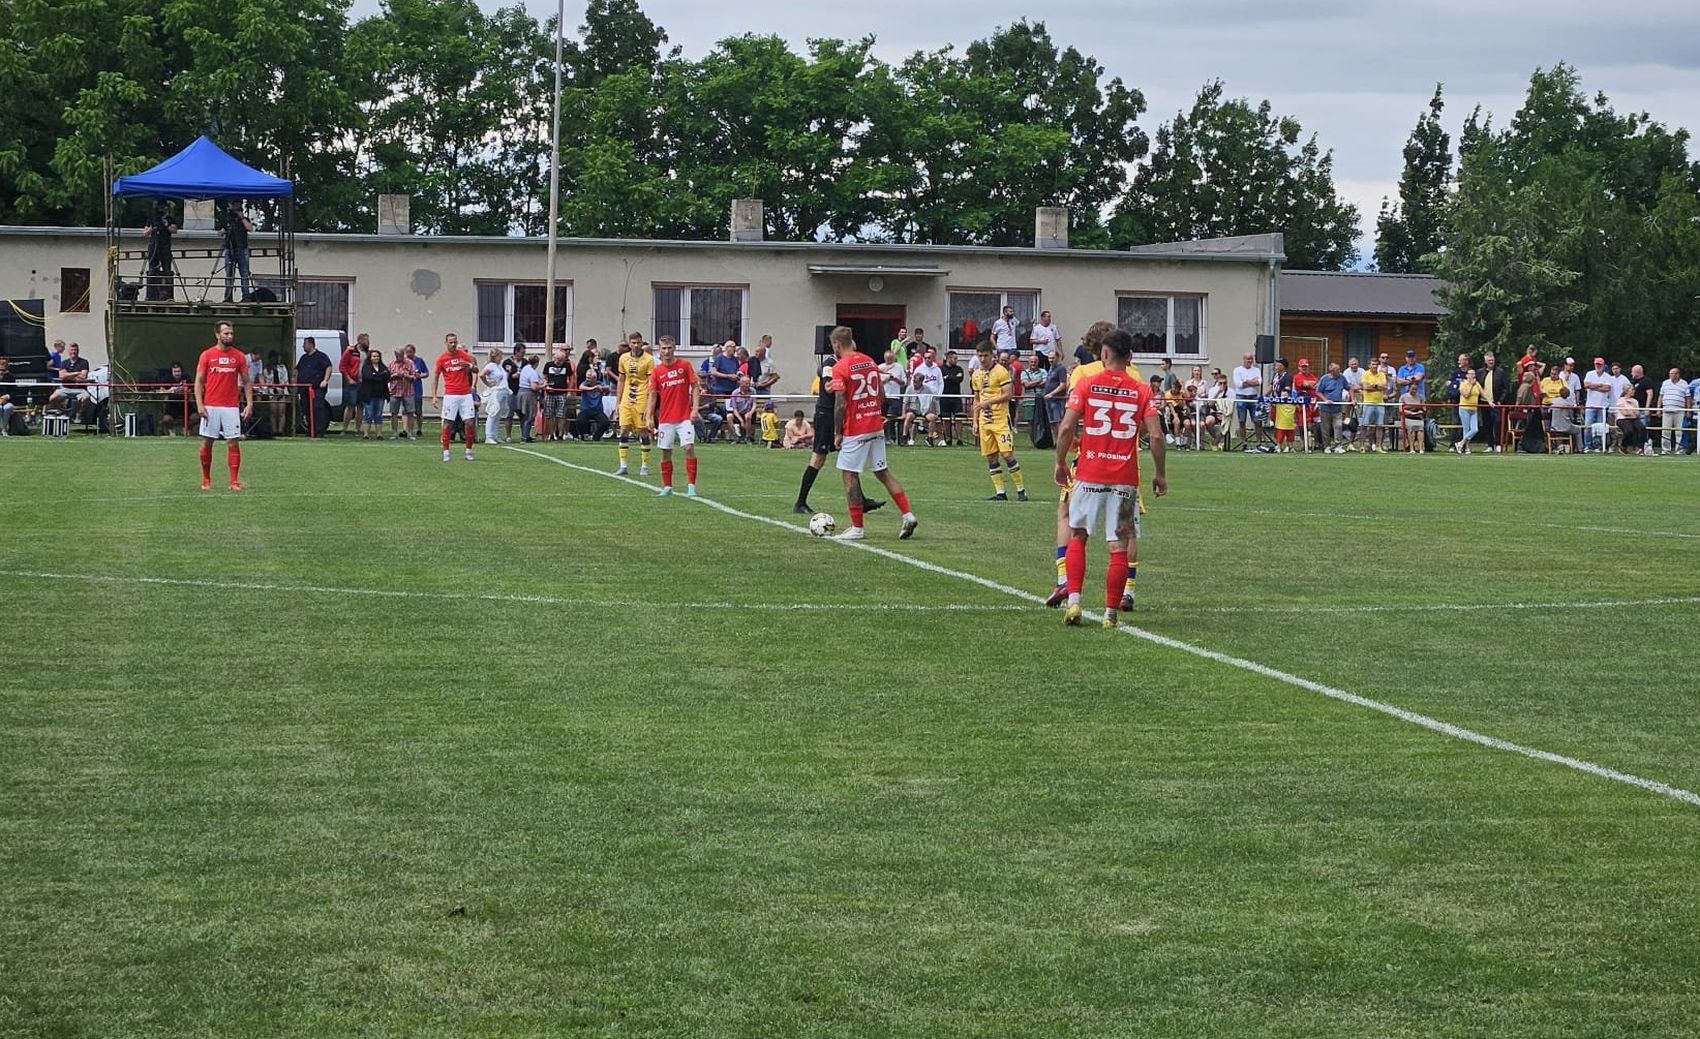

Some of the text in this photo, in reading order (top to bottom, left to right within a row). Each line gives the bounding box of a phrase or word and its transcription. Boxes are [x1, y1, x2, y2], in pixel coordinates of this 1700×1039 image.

[850, 370, 879, 400] 20
[1085, 398, 1138, 439] 33
[1001, 434, 1012, 444] 34
